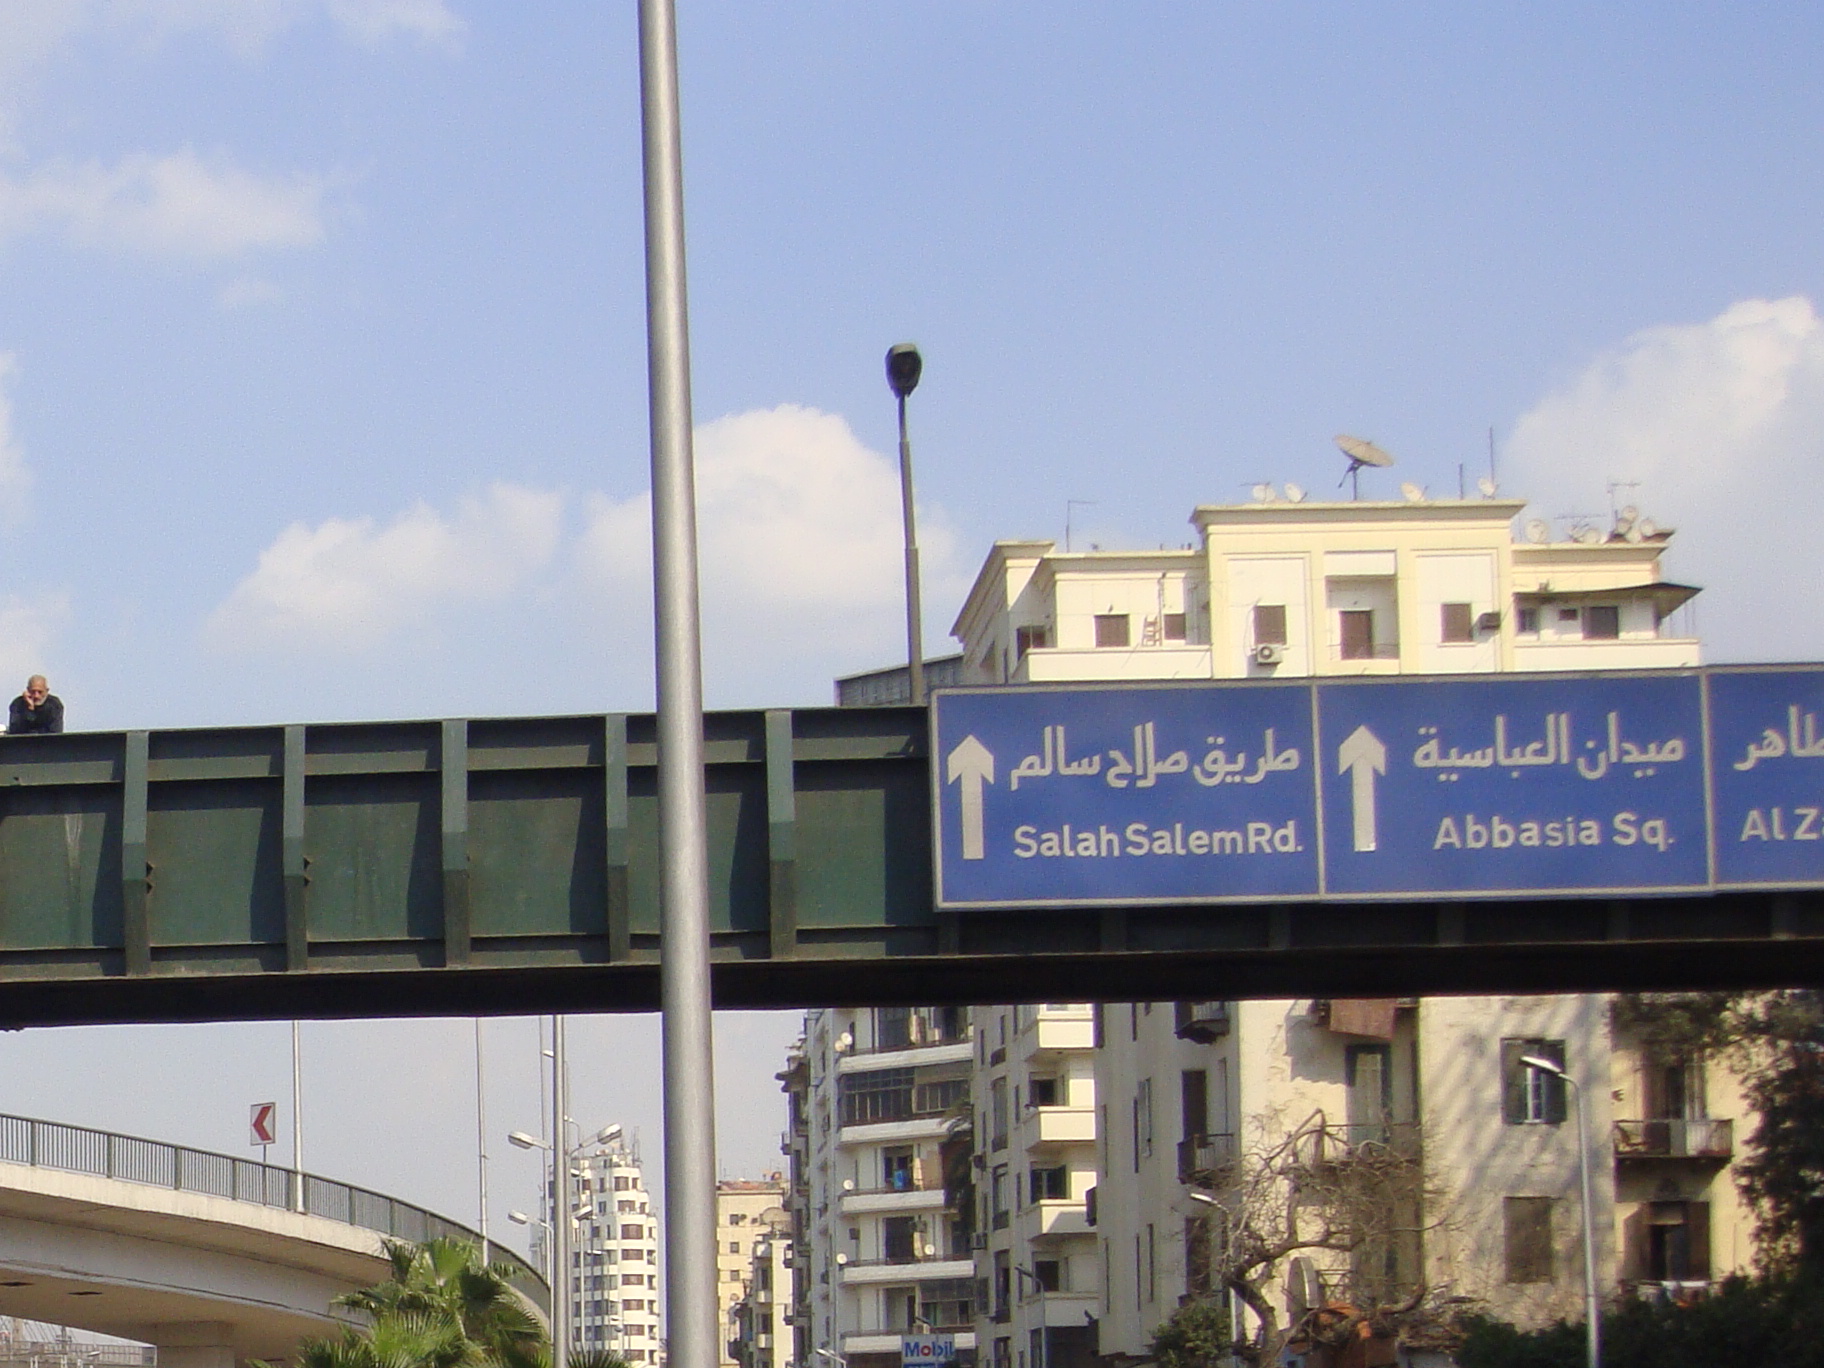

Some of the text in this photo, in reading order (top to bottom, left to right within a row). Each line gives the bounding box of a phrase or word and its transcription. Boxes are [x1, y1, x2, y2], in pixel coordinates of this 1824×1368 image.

[1009, 721, 1300, 791] طريق صلاح سالم
[1413, 711, 1686, 782] ميدان العباسية
[1013, 819, 1304, 858] Salah Salem Rd.
[1432, 812, 1676, 852] Abbasia Sq.
[904, 1341, 953, 1357] Mobil
